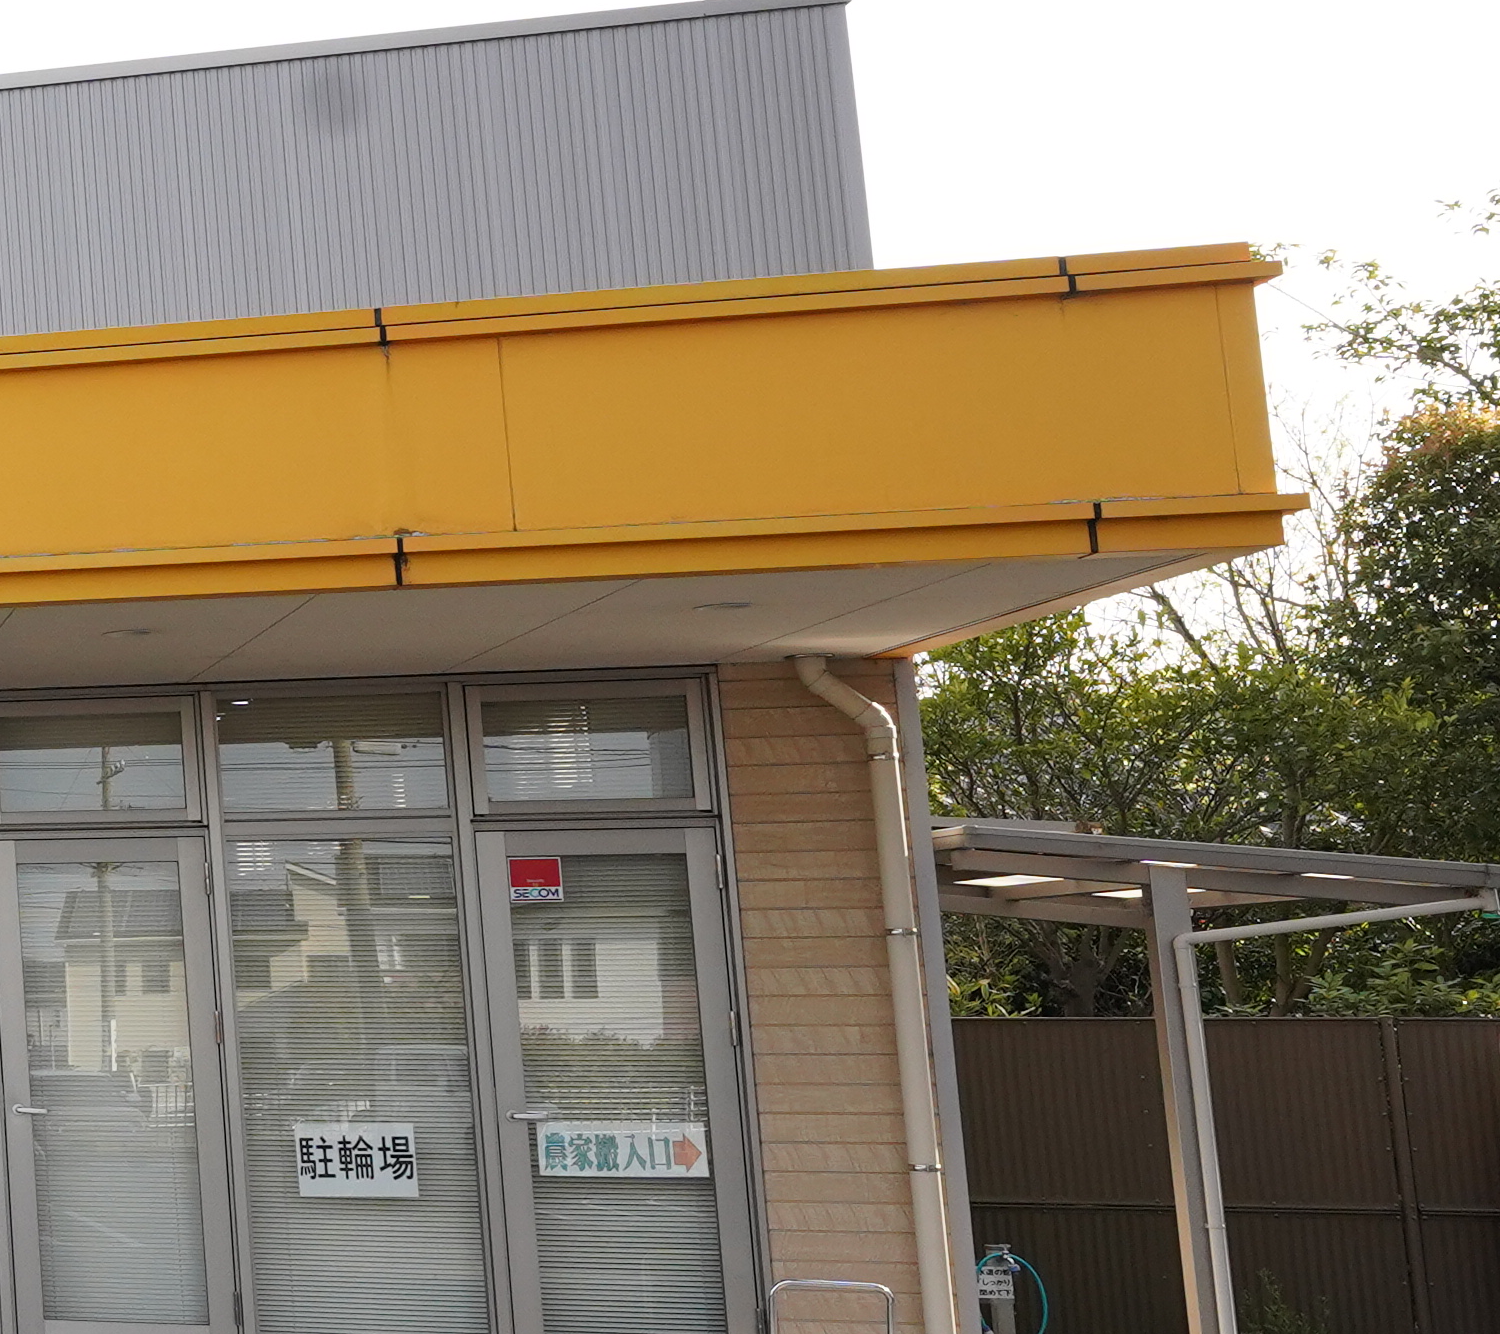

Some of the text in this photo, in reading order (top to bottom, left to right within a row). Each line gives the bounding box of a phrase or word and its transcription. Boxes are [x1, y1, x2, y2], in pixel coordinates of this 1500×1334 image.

[513, 887, 560, 899] SECOM
[299, 1135, 415, 1181] 駐輪場
[544, 1131, 672, 1173] 農家搬入口
